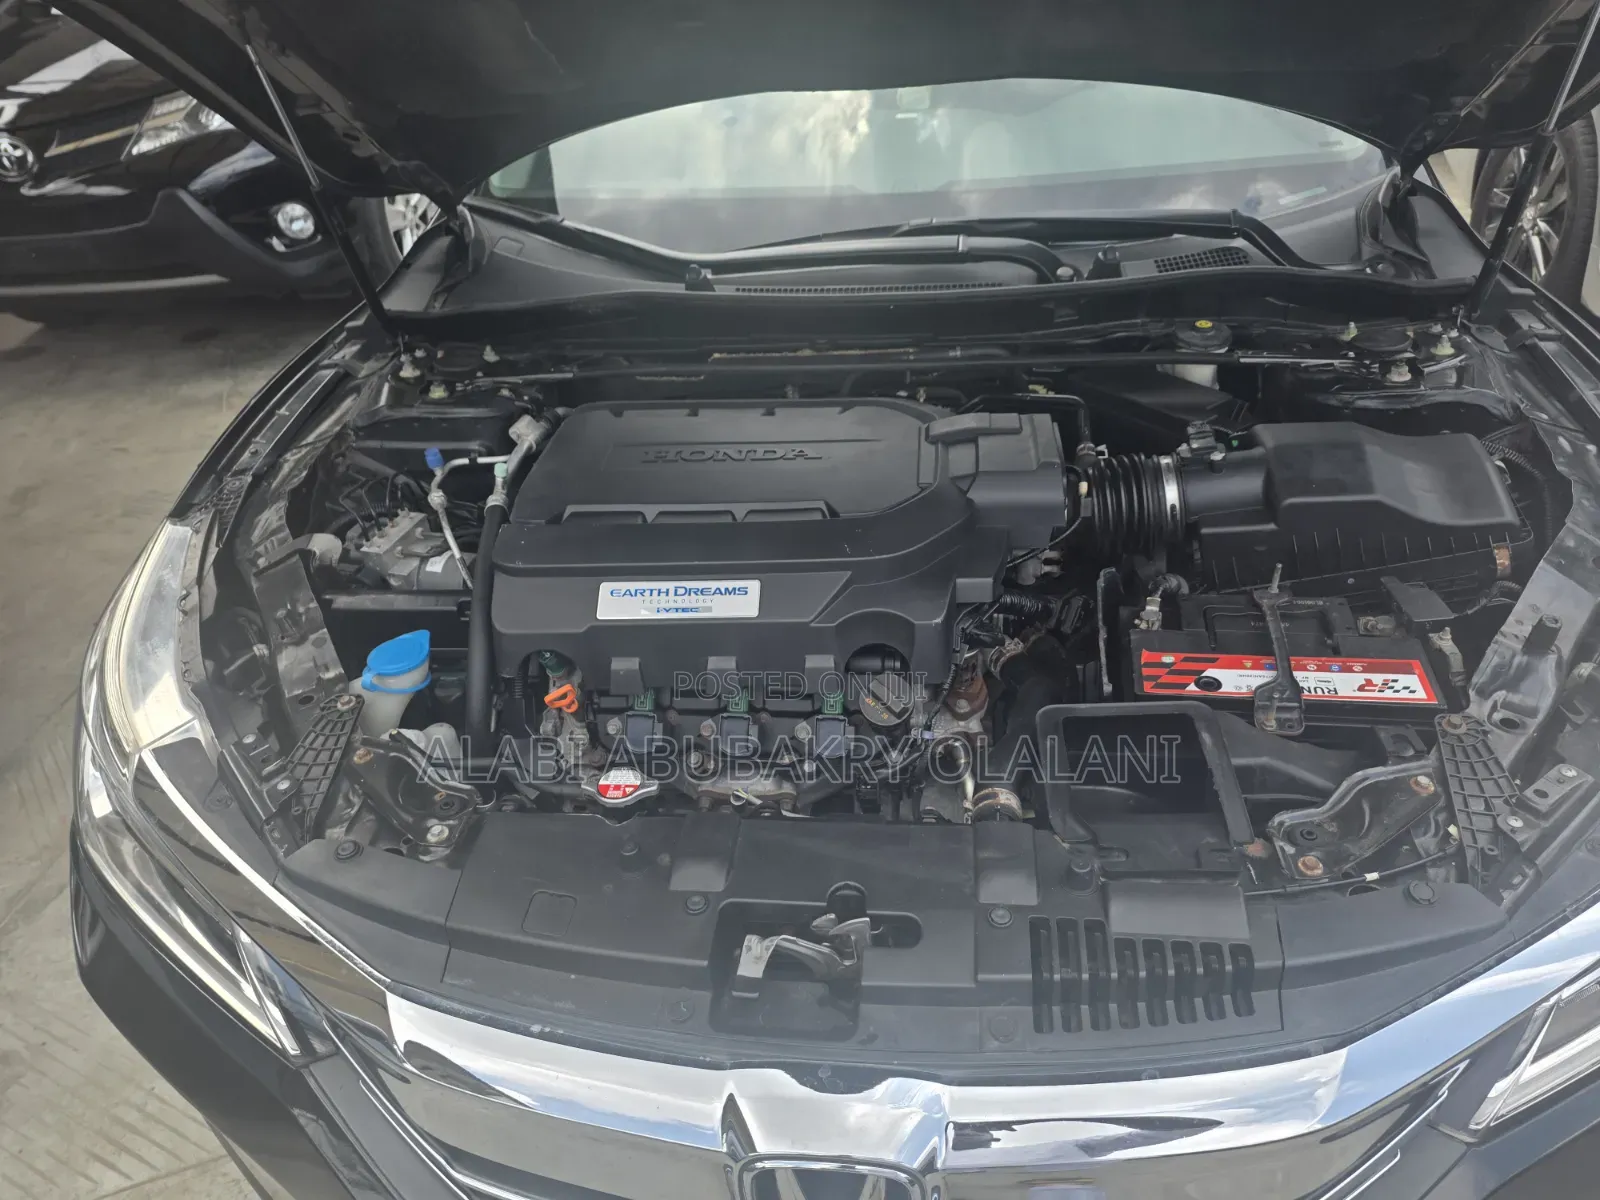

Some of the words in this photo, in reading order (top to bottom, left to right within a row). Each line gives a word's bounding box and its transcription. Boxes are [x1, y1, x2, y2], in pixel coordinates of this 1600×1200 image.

[641, 449, 822, 463] HONDA
[610, 588, 669, 597] EARTH
[674, 586, 749, 597] DREAMS
